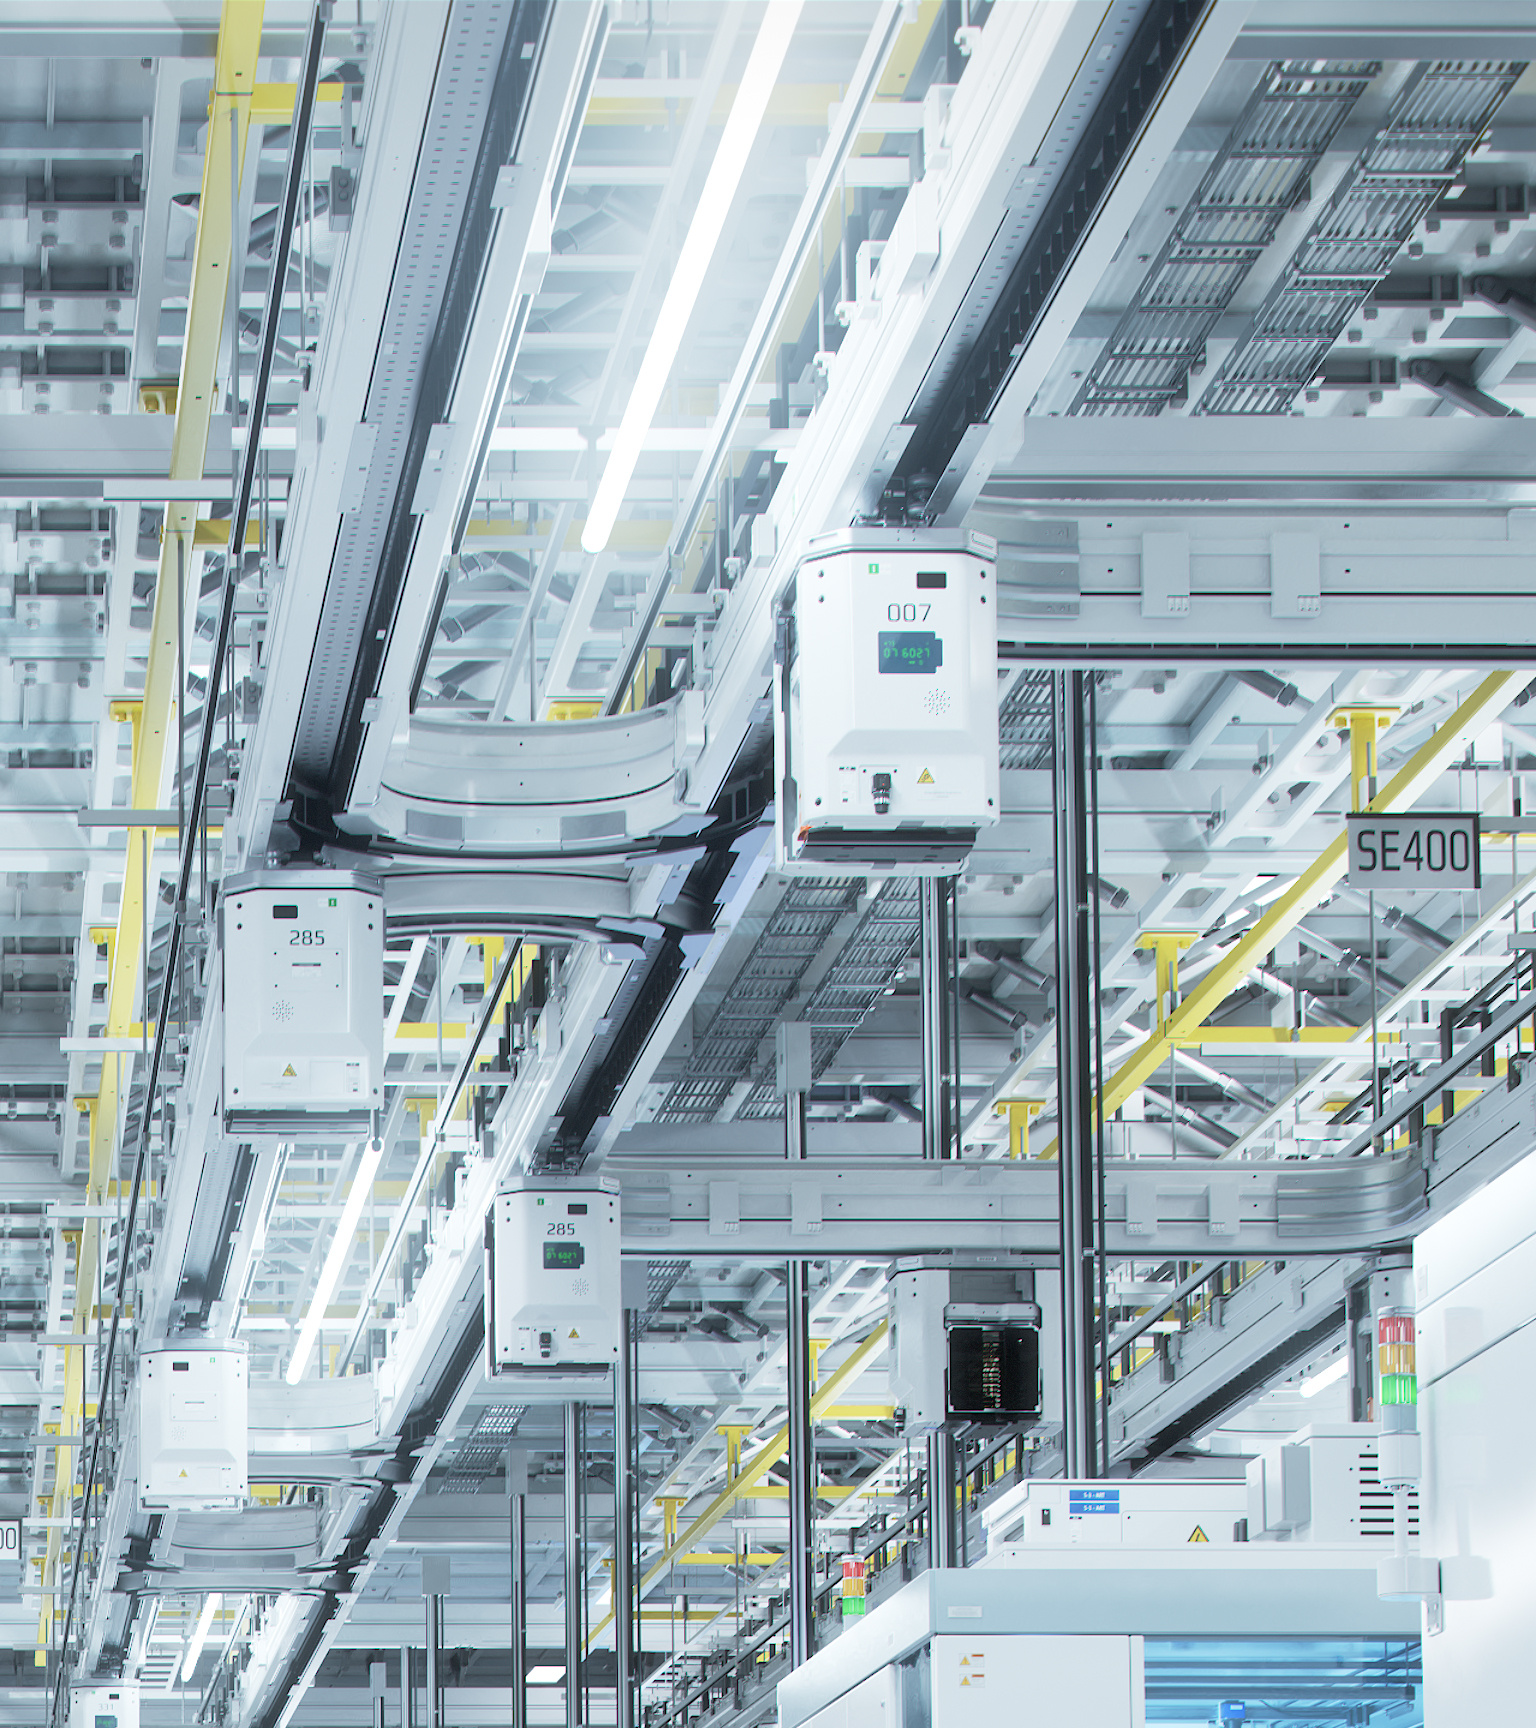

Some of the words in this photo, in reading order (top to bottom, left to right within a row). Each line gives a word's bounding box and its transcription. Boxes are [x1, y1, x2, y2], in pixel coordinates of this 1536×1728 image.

[887, 603, 932, 622] 007
[1356, 829, 1469, 871] SE400
[289, 929, 325, 946] 285
[546, 1222, 575, 1236] 285
